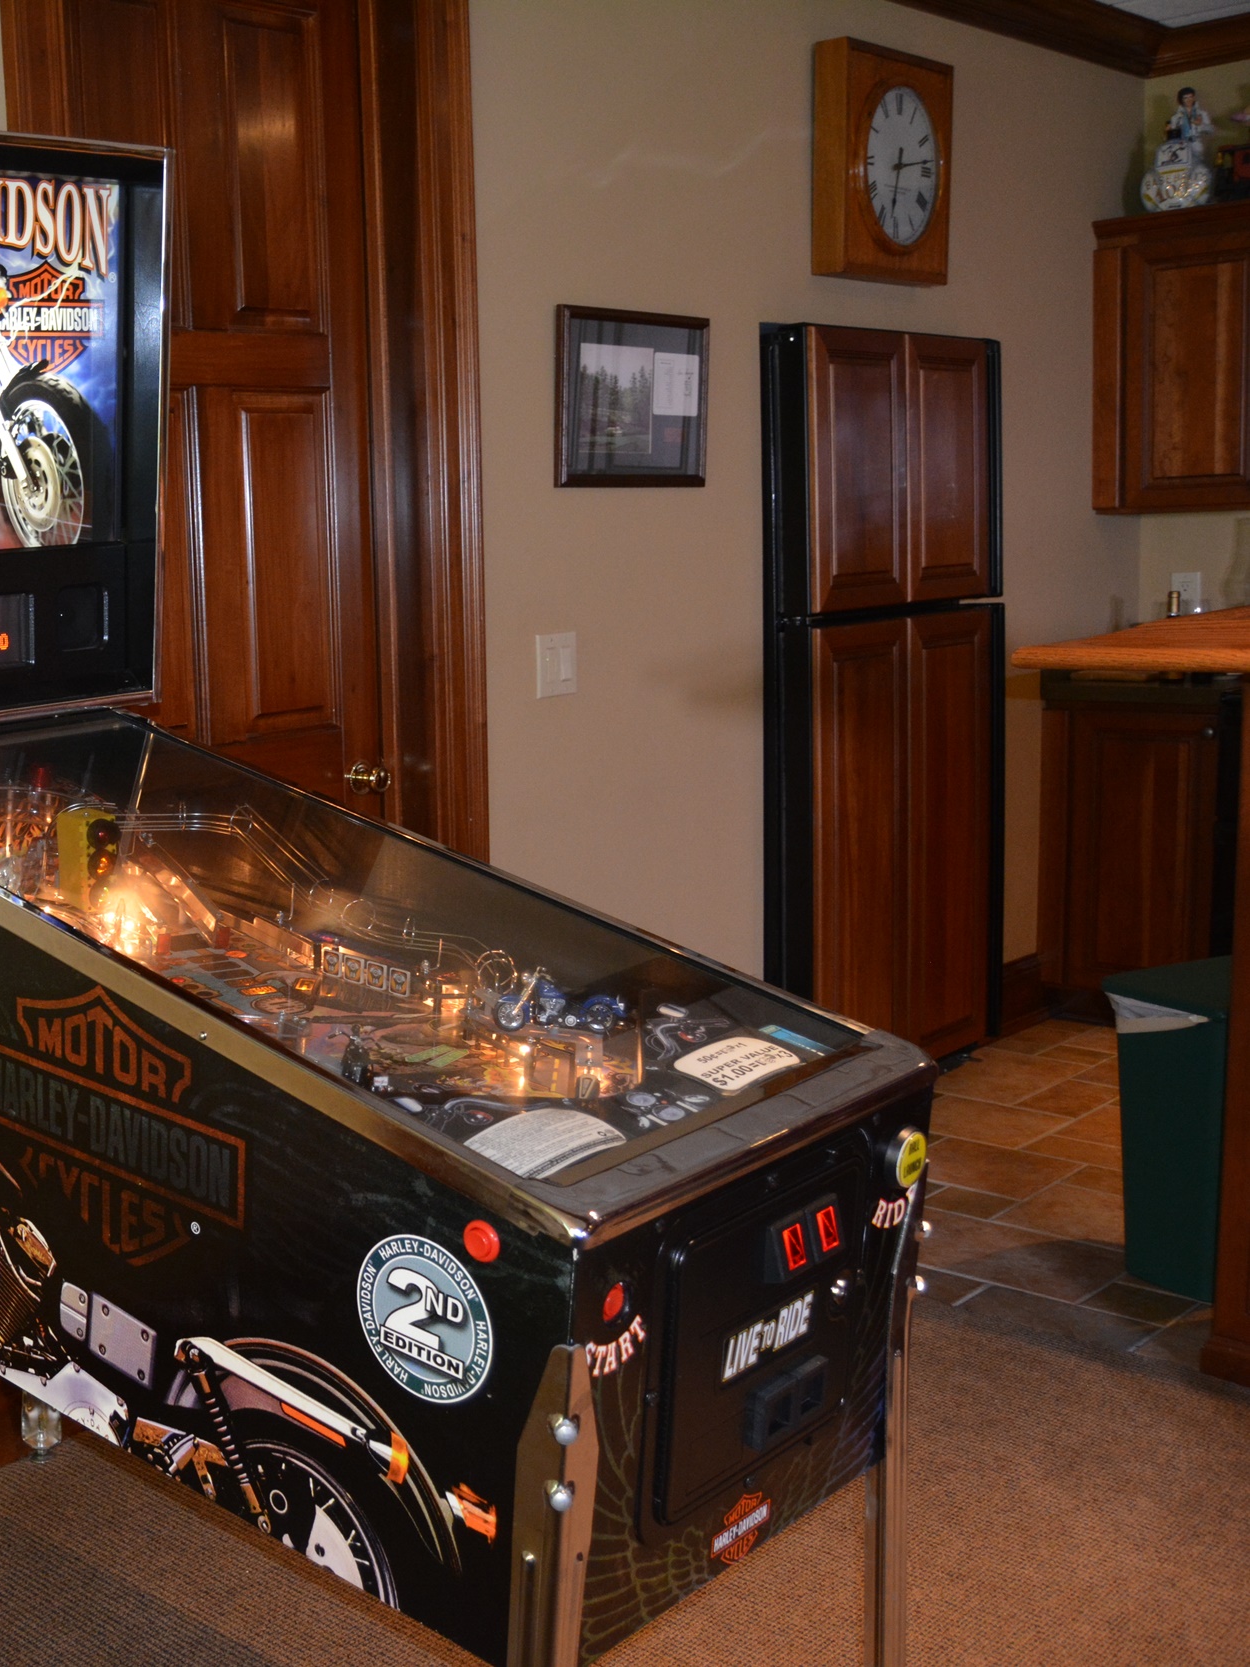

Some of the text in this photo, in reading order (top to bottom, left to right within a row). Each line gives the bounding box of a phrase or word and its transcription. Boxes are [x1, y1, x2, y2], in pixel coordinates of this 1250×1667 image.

[38, 1005, 167, 1098] MOTOR
[701, 1044, 779, 1078] SUPER VALUE
[378, 1239, 477, 1300] HARLEY-DAVIDSON
[361, 1264, 409, 1384] HARLEY-DAVIDSON
[386, 1266, 464, 1351] 2ND
[722, 1290, 815, 1382] LIVE TO RIDE
[383, 1330, 461, 1376] EDITION
[585, 1314, 647, 1377] START
[713, 1503, 768, 1553] HARLEY-DAVIDSON
[729, 1499, 757, 1523] MOTOR
